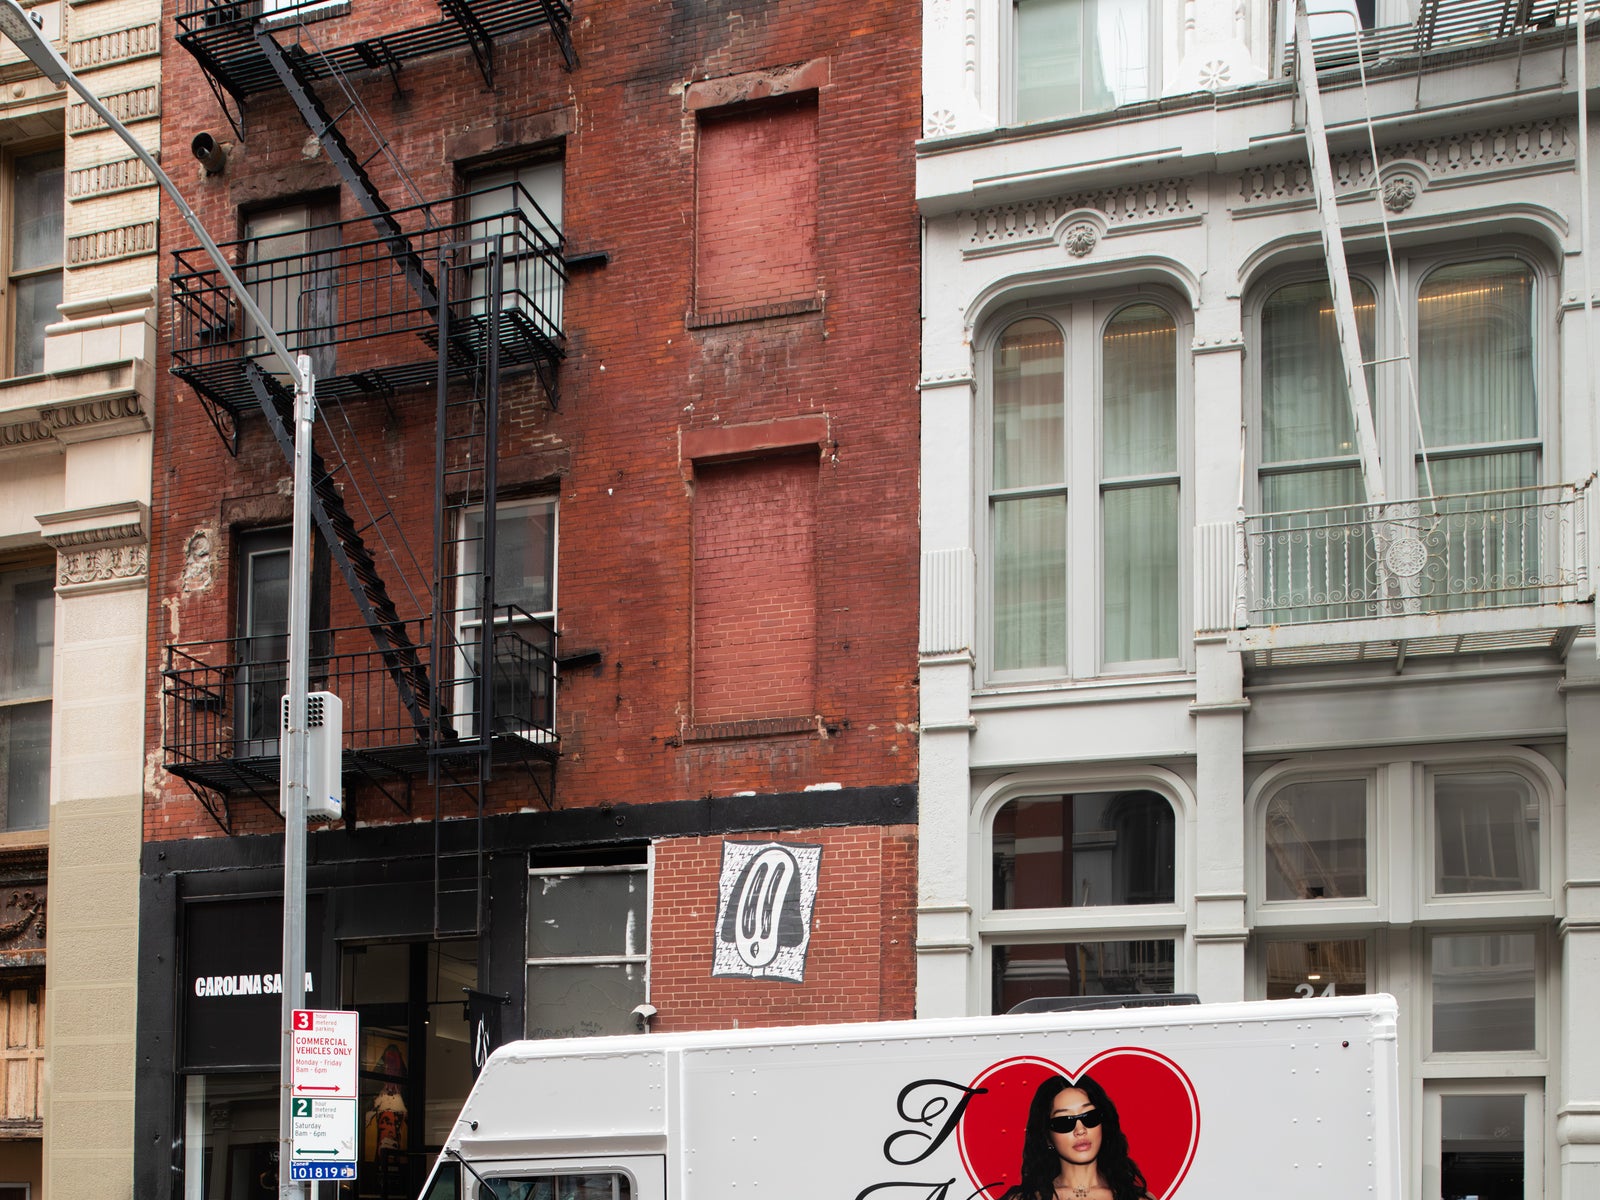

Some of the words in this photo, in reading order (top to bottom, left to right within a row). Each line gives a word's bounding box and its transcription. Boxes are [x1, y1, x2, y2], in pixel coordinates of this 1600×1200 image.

[195, 974, 262, 997] CAROLINA
[263, 971, 313, 994] SAA
[298, 1012, 309, 1029] 3
[295, 1037, 348, 1046] COMMERCIAL
[295, 1046, 332, 1055] VEHICLES
[333, 1047, 353, 1056] ONLY
[295, 1059, 319, 1067] Monday
[324, 1059, 342, 1067] Friday
[297, 1099, 308, 1116] 2
[295, 1122, 321, 1130] Saturday
[313, 1130, 327, 1138] 6pm
[292, 1167, 339, 1178] 101819
